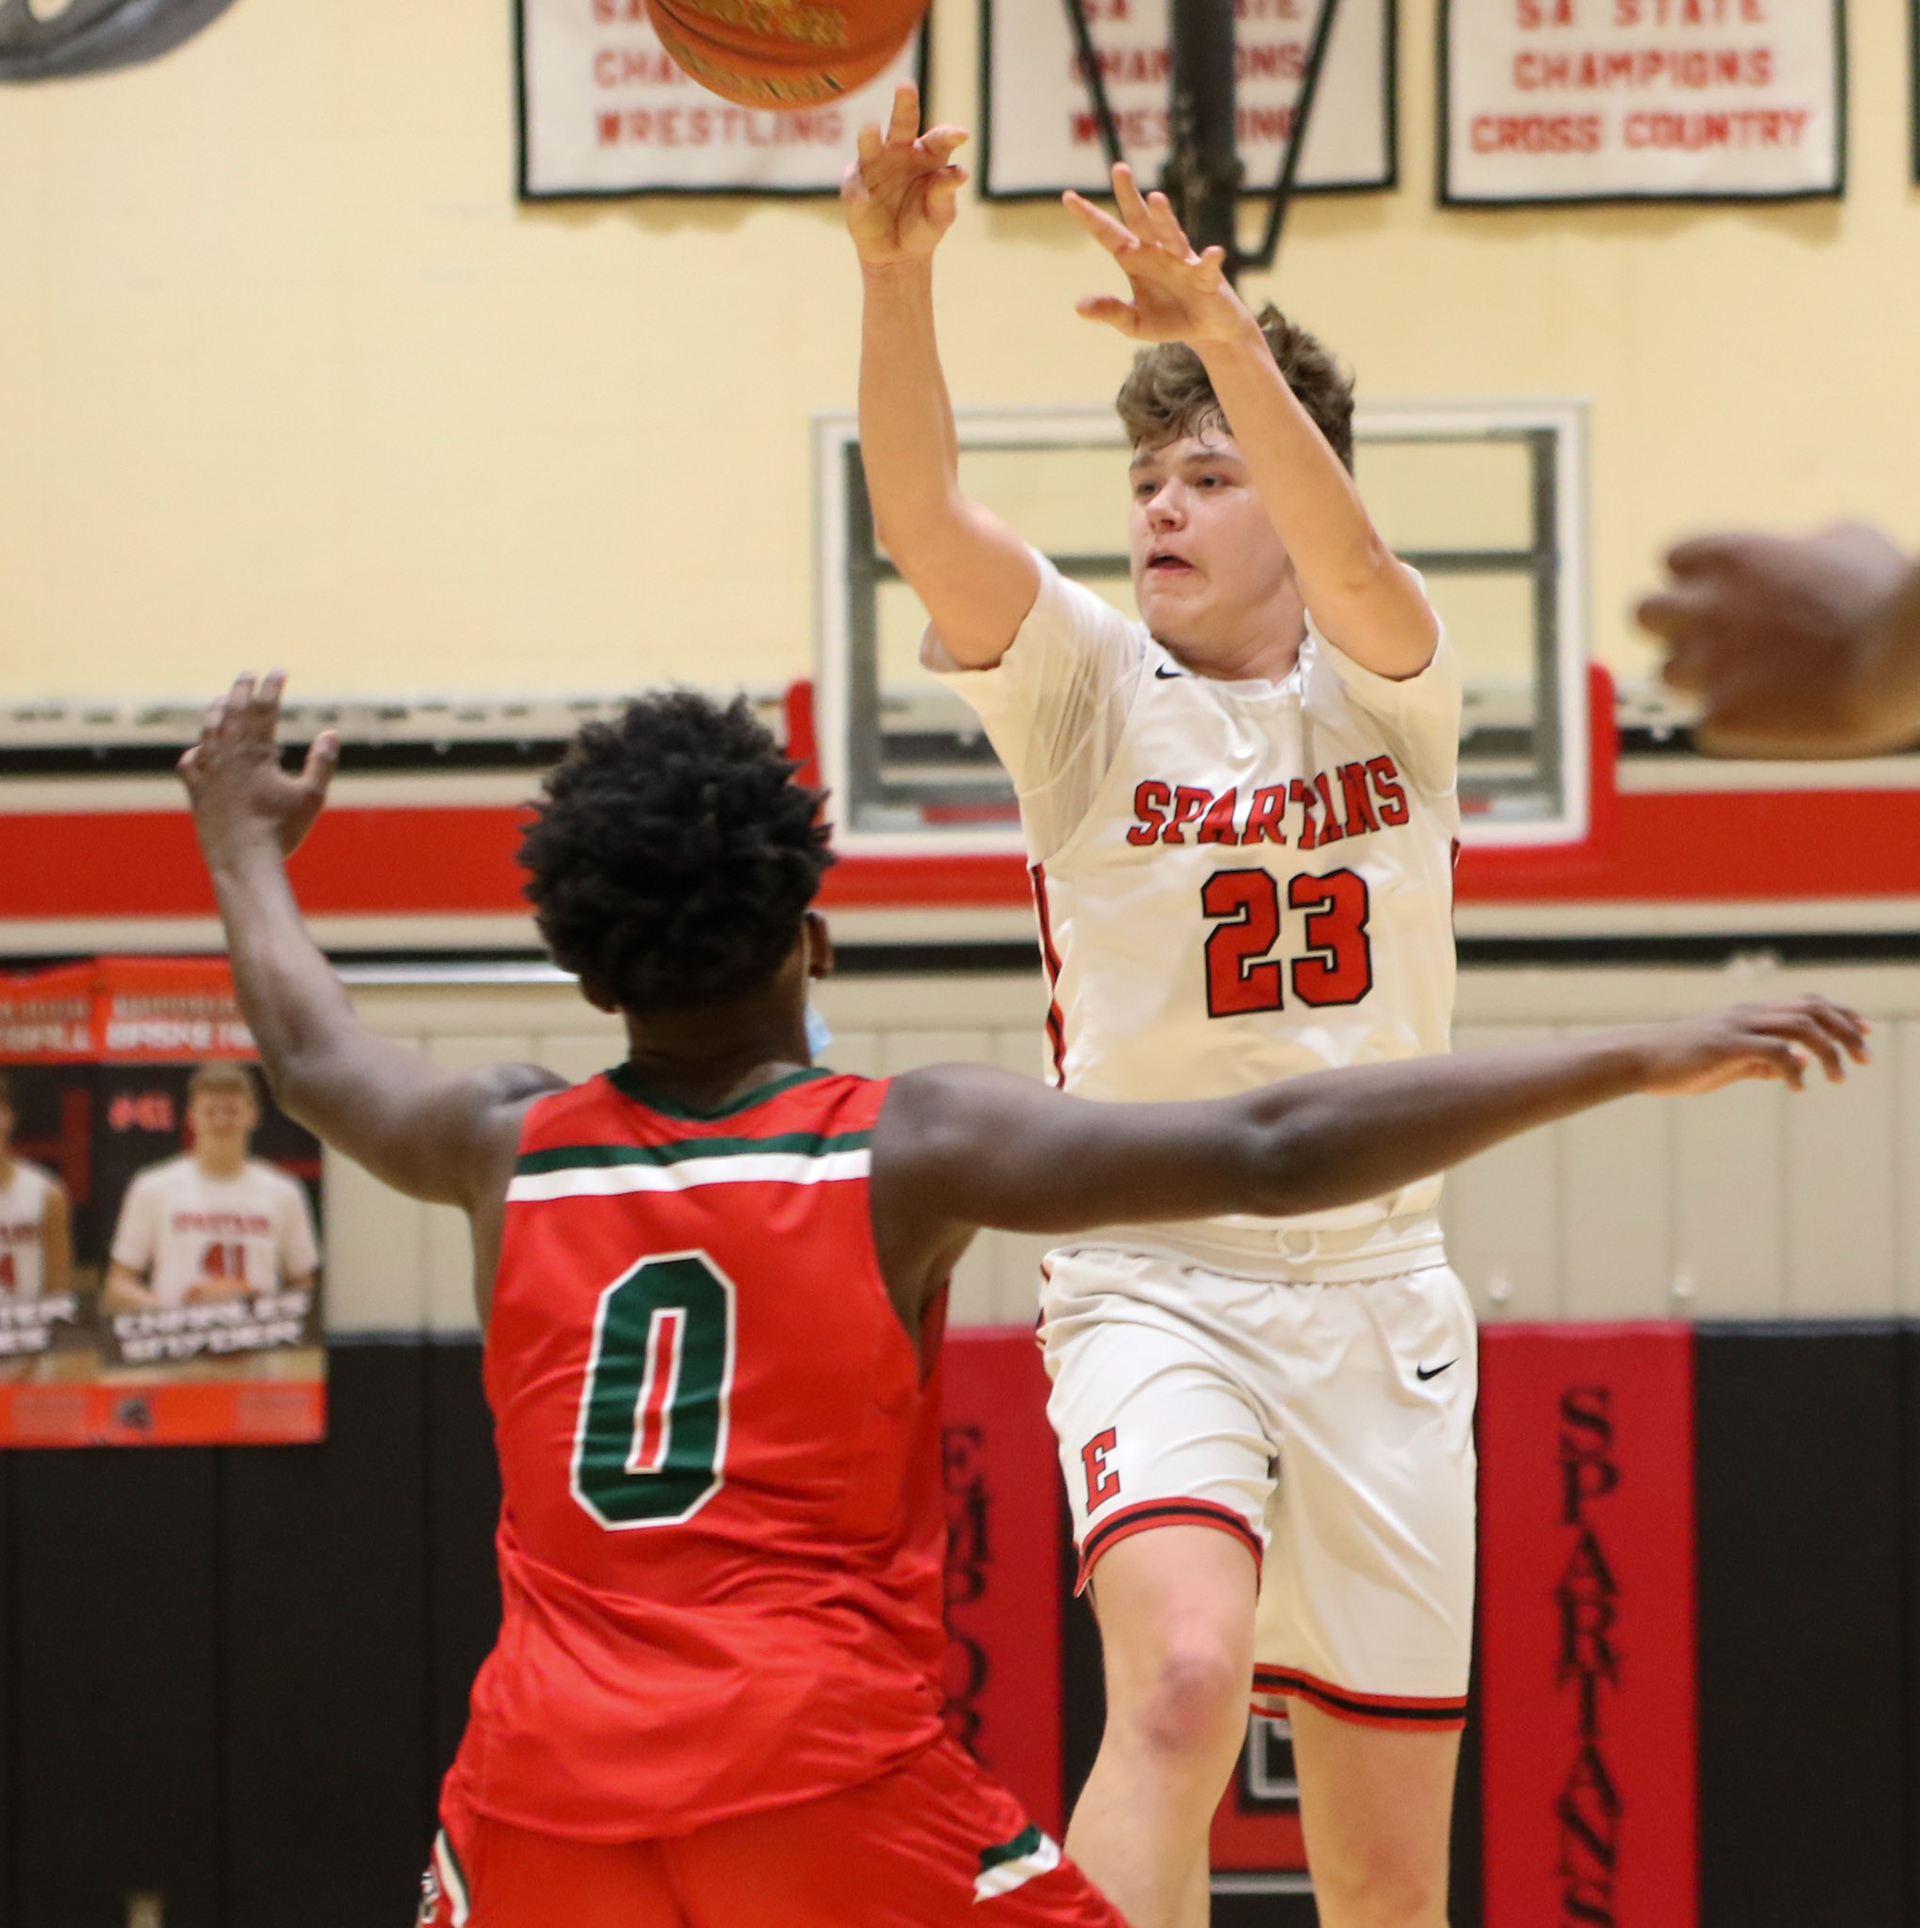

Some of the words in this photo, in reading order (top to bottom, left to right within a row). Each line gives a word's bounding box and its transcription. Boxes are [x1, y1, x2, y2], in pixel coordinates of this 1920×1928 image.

[1614, 0, 1764, 27] STATE
[1513, 48, 1773, 90] CHAMPIONS
[596, 108, 842, 146] WRESTLING
[1471, 115, 1600, 154] CROSS
[1624, 110, 1808, 152] COUNTRY
[1126, 755, 1410, 850] SPARTANS
[1201, 867, 1373, 1019] 23
[1080, 1427, 1120, 1515] E
[1553, 1386, 1625, 1928] SPARTANS
